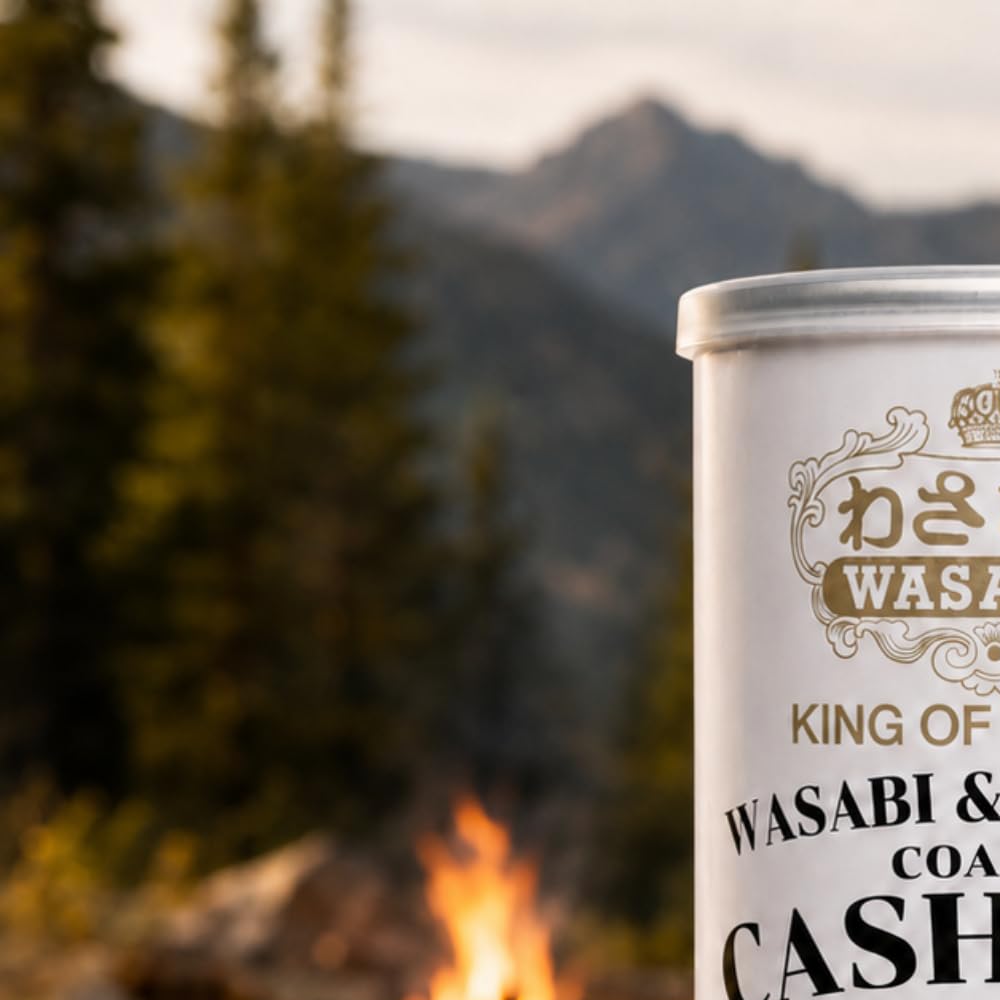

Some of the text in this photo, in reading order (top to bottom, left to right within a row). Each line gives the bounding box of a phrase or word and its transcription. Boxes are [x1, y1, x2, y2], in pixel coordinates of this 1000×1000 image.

[792, 703, 903, 746] KING
[919, 703, 992, 746] OF
[725, 773, 936, 855] WASABI
